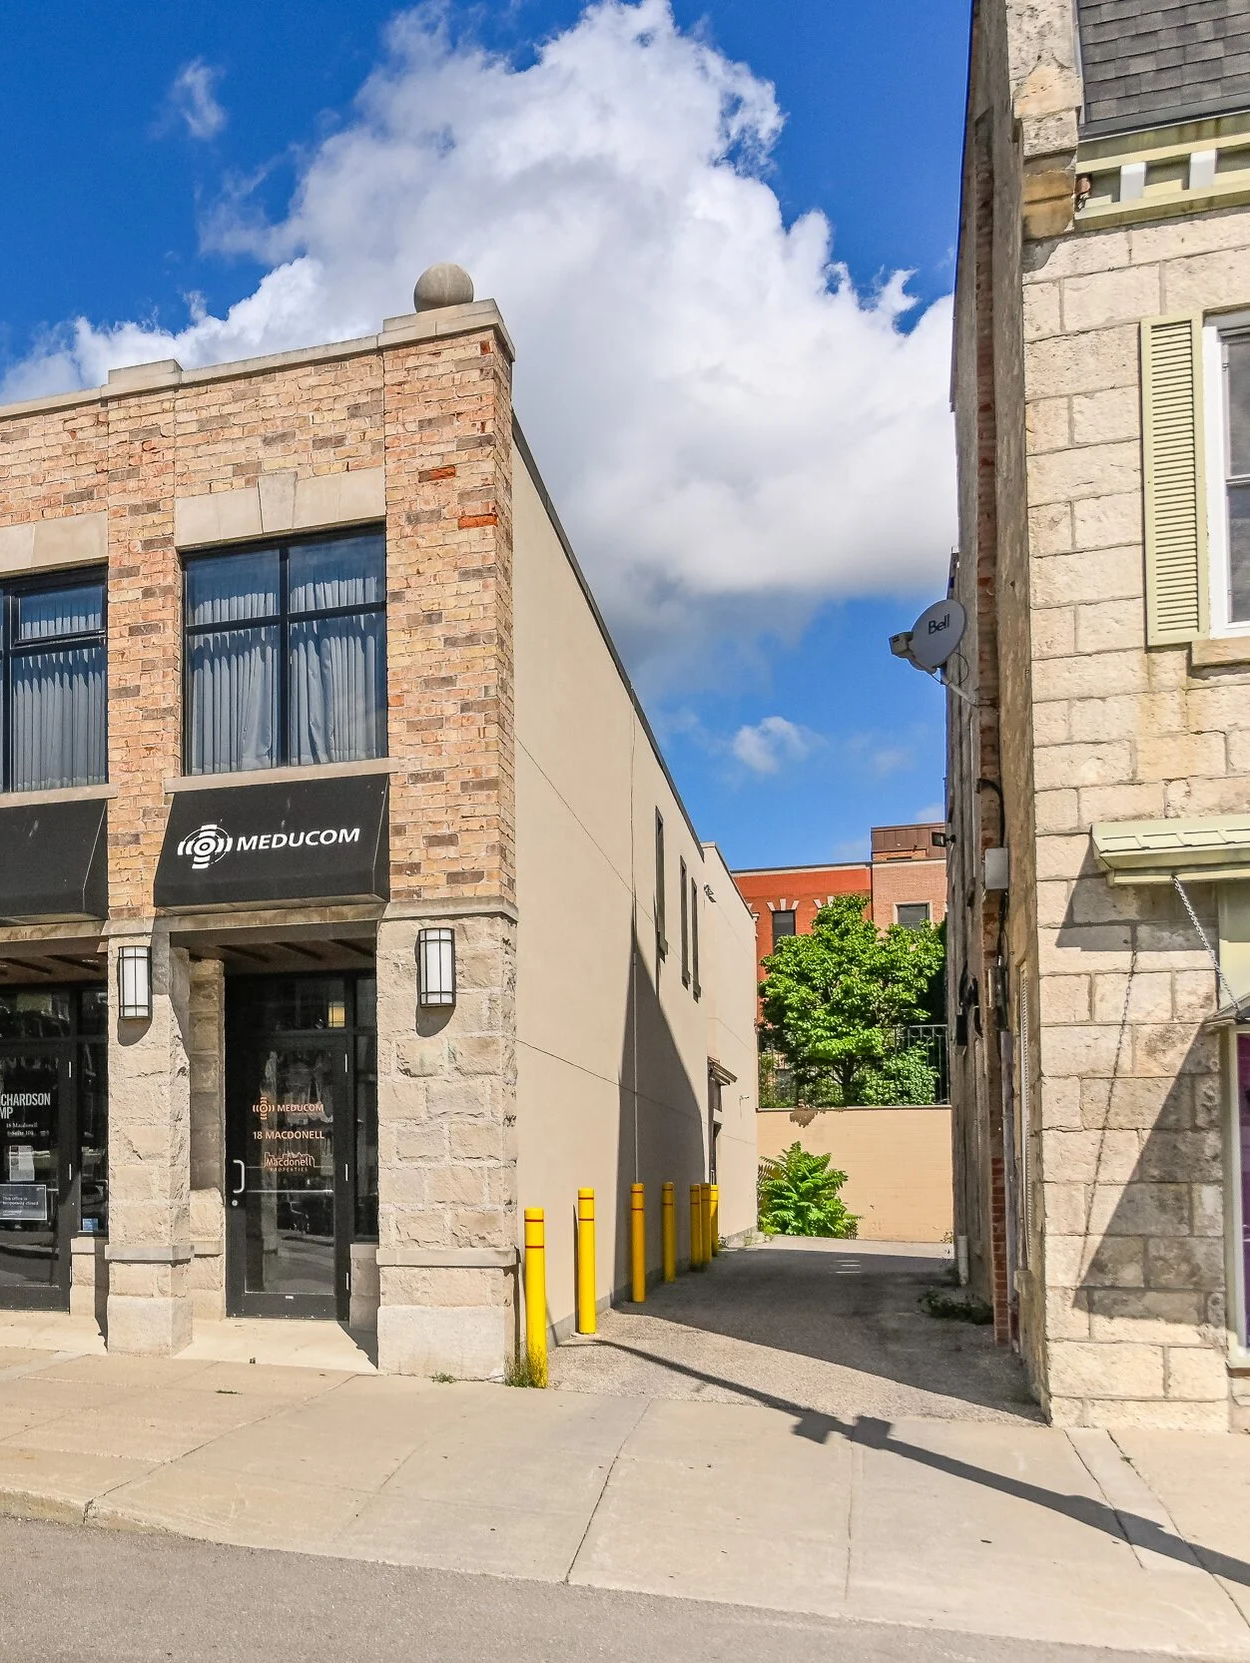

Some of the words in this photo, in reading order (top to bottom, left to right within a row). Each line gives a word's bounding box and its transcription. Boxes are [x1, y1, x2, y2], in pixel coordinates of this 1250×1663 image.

[928, 613, 950, 634] Bell
[236, 828, 361, 852] MEDUCOM
[277, 1104, 324, 1112] MEDUCOM
[252, 1131, 263, 1140] 18
[265, 1130, 326, 1140] MACDONELL
[266, 1157, 312, 1167] Macdonell
